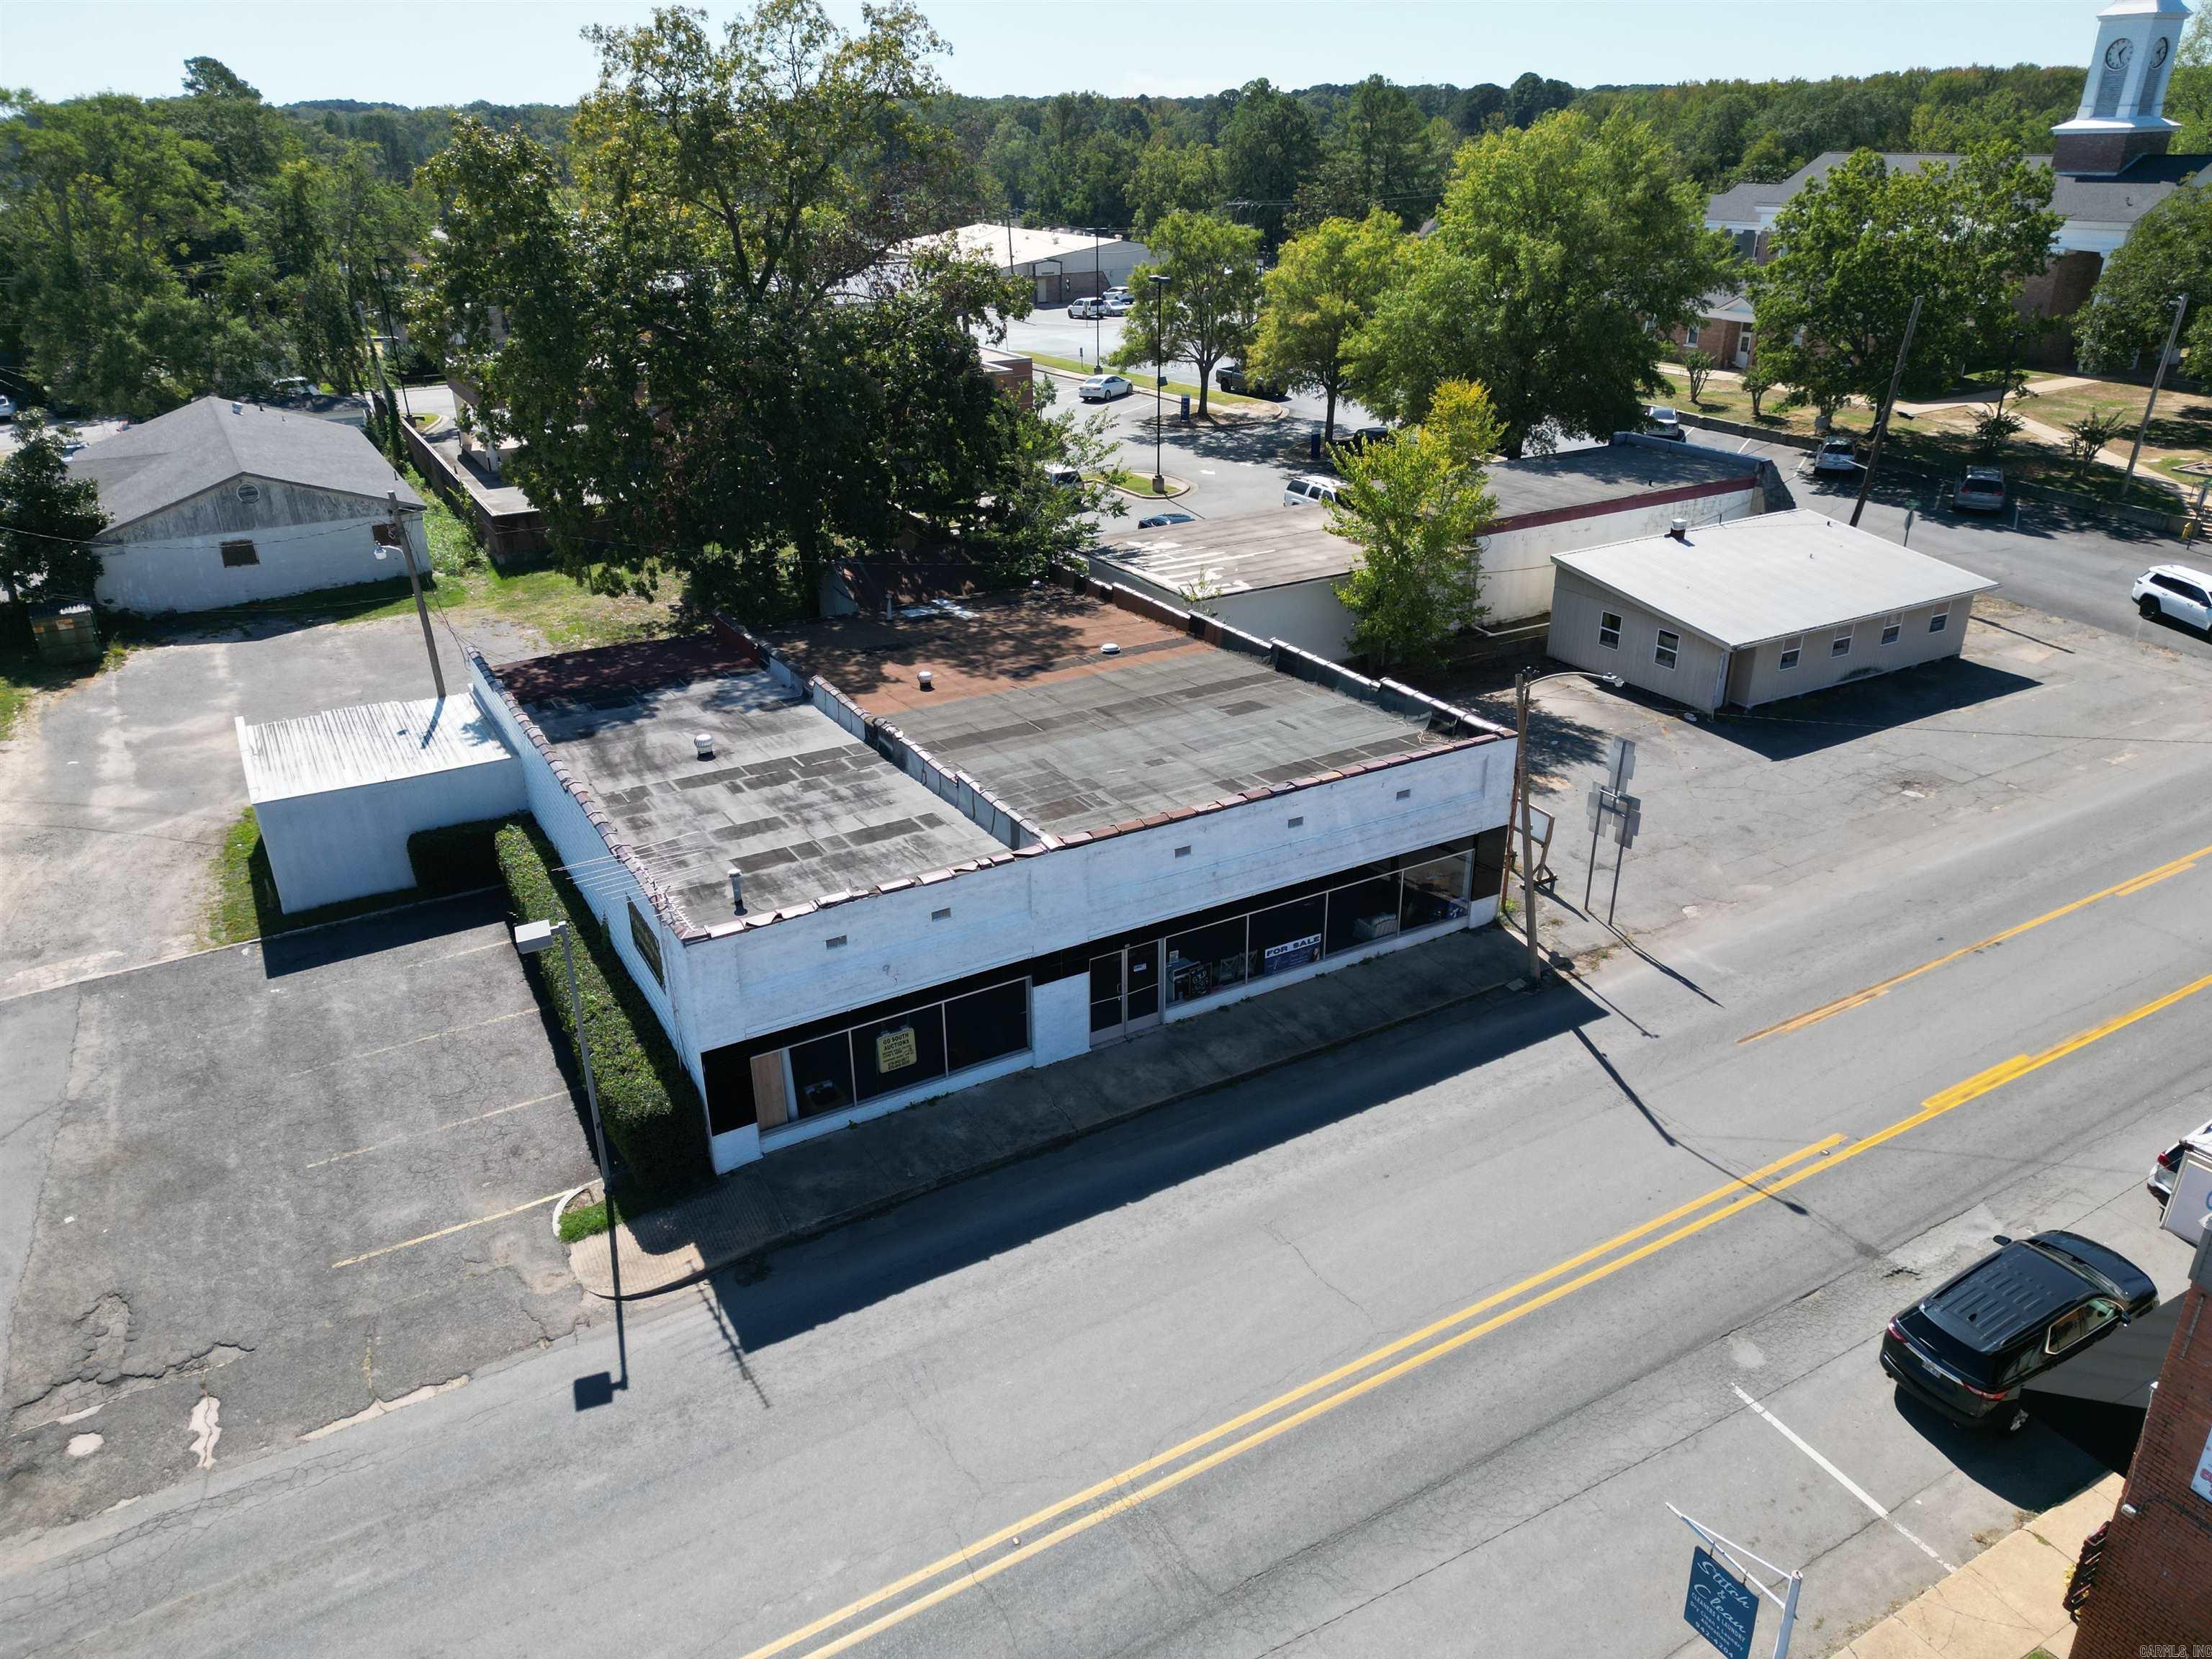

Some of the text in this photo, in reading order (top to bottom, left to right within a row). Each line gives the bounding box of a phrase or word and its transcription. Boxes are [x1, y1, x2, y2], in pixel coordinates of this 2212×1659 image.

[1267, 935, 1320, 956] FOR SALE
[884, 1039, 909, 1051] AUCTIONS
[891, 1033, 909, 1042] SOUTH
[1697, 1561, 1750, 1609] Stitch
[1717, 1589, 1726, 1599] &
[1691, 1592, 1716, 1617] CLEANERS
[1722, 1618, 1746, 1642] LAUNDRY
[1694, 1584, 1746, 1633] Clean
[1721, 1628, 1744, 1652] Laundry
